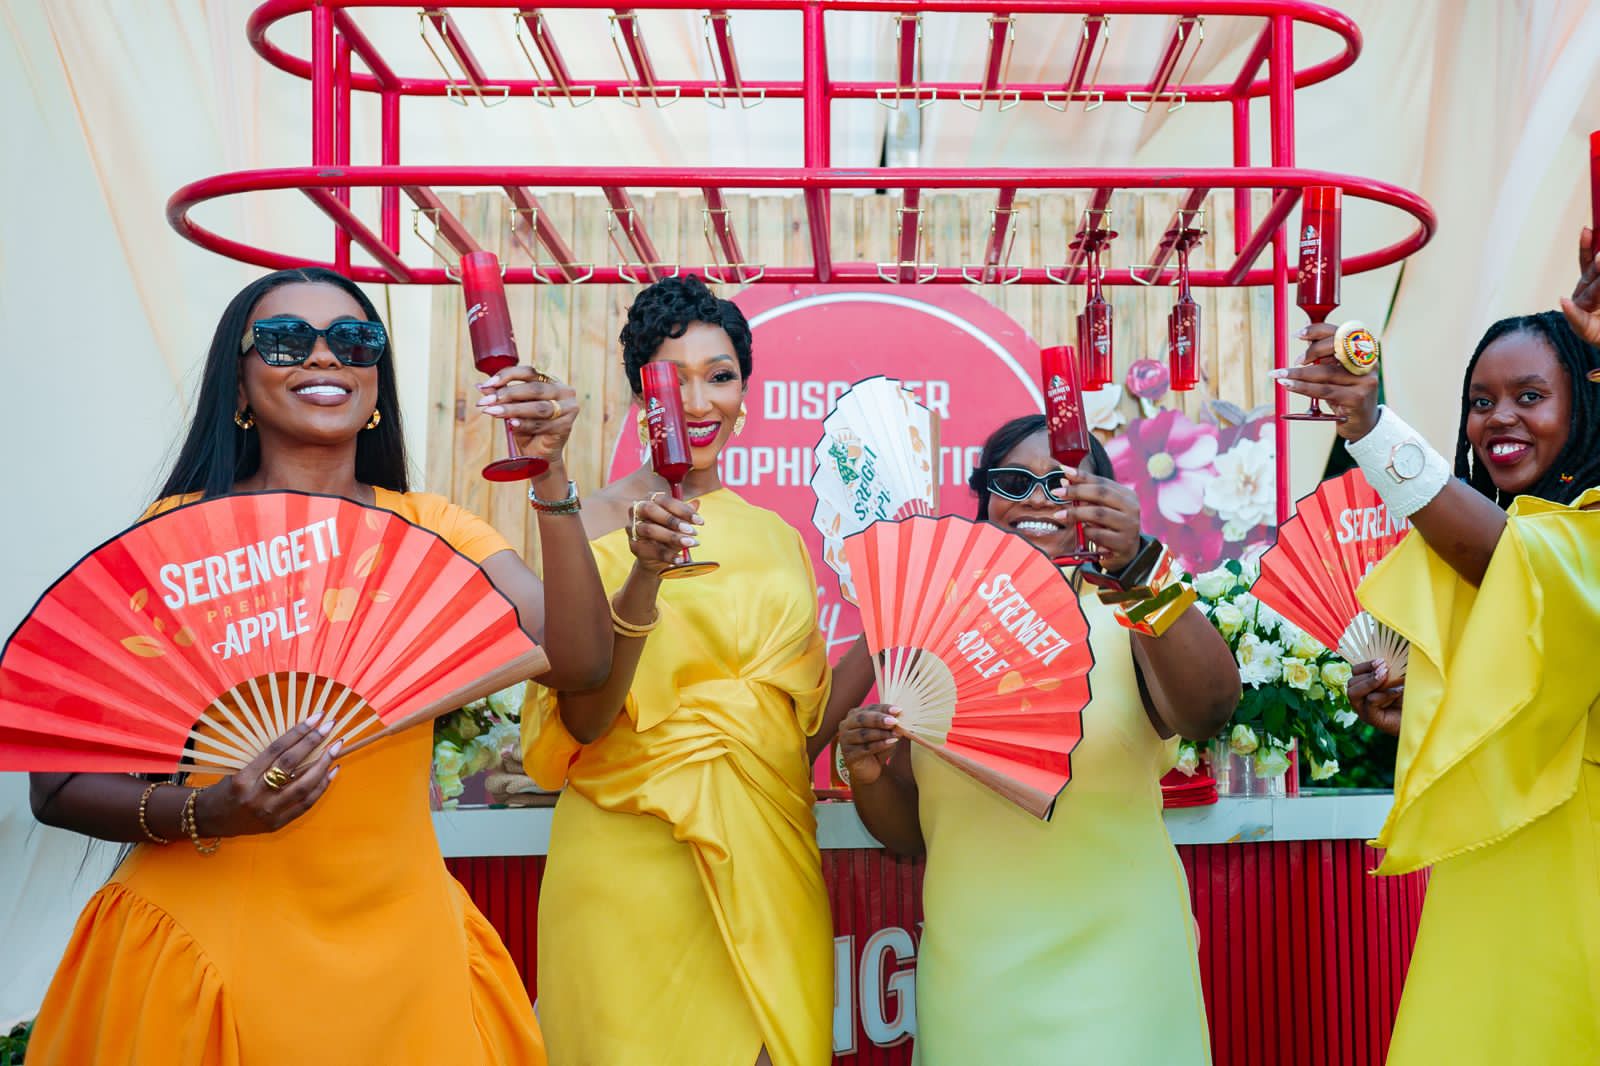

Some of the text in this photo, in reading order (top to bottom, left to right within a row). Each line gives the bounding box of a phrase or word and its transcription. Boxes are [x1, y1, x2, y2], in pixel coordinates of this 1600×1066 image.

[763, 380, 950, 421] DISCR
[159, 516, 341, 611] SERENGETI
[211, 598, 311, 661] APPLE
